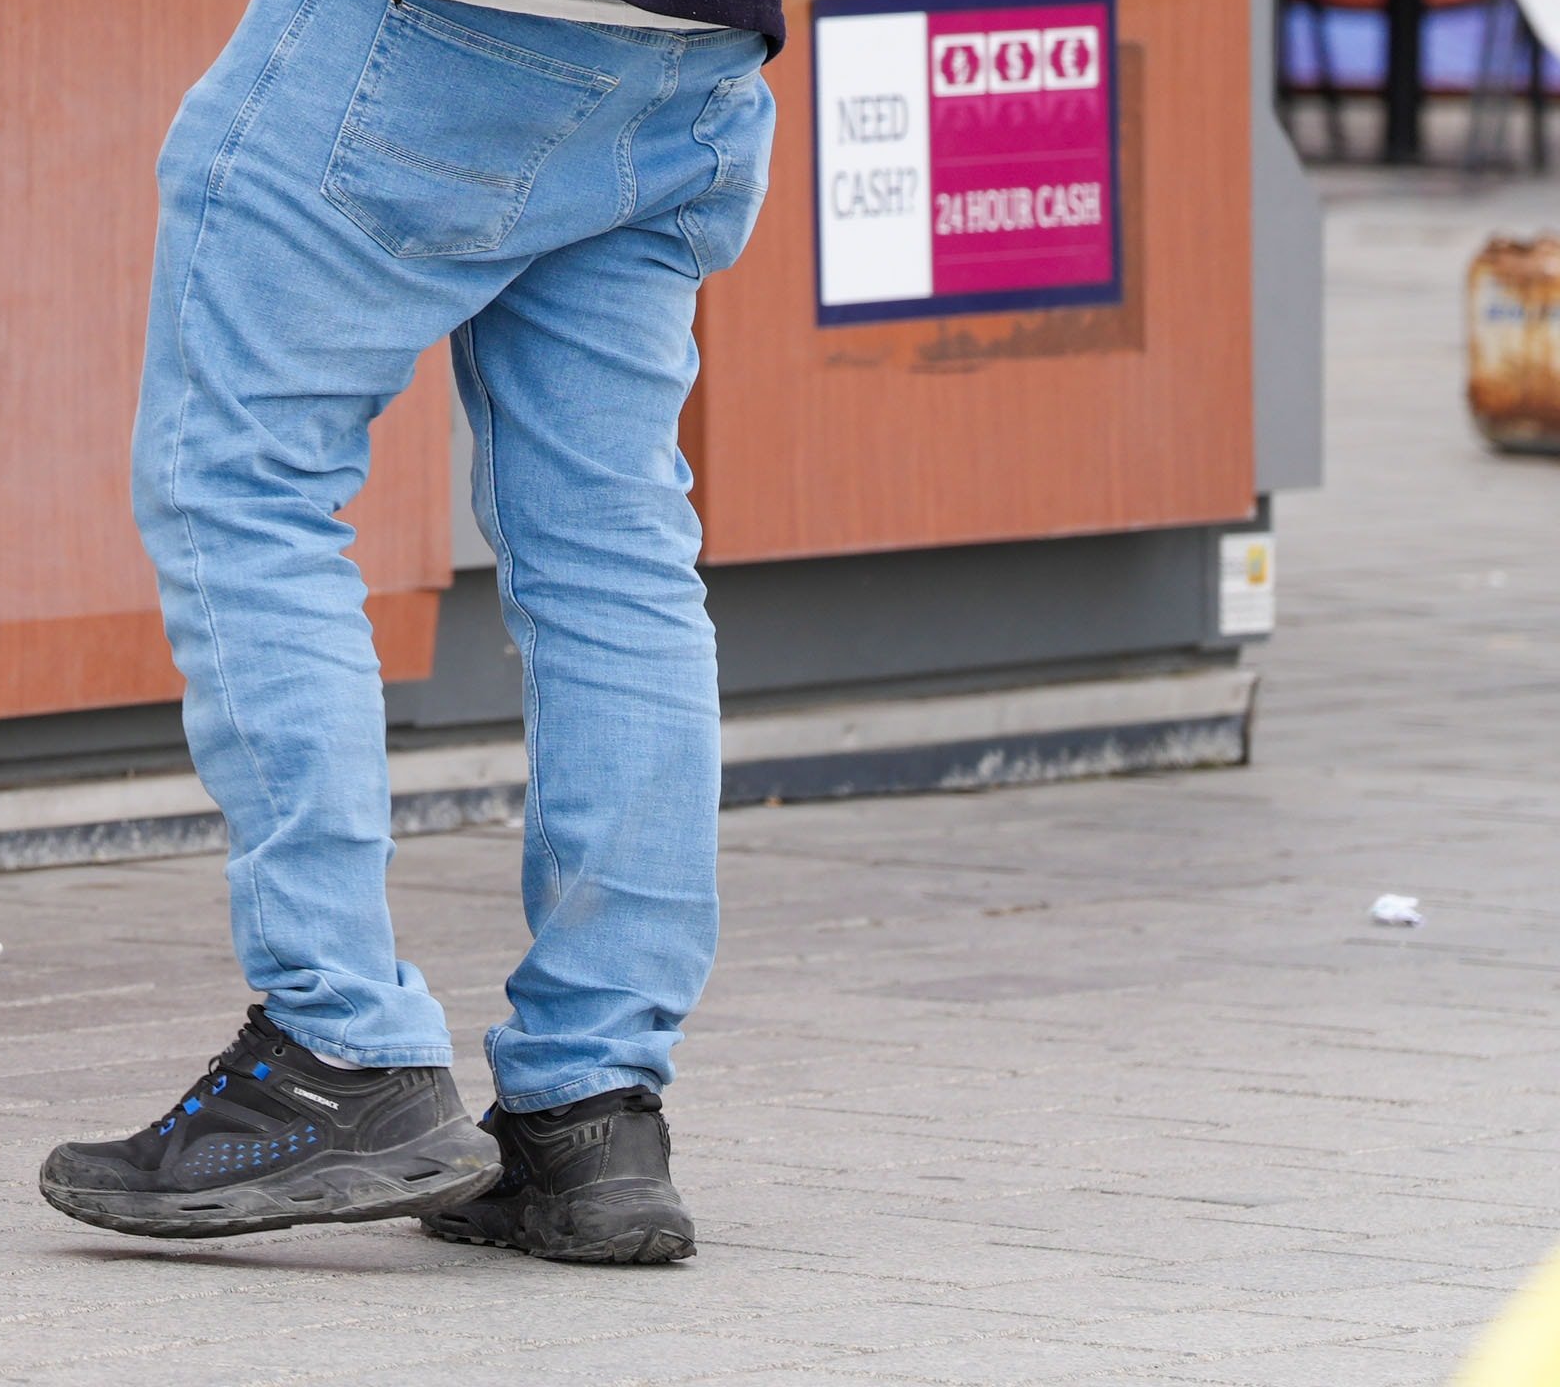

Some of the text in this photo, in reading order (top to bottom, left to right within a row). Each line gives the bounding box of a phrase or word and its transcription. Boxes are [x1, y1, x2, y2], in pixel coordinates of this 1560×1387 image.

[836, 94, 909, 145] NEED
[832, 168, 918, 220] CASH?
[935, 182, 1101, 235] 24 HOUR CASH
